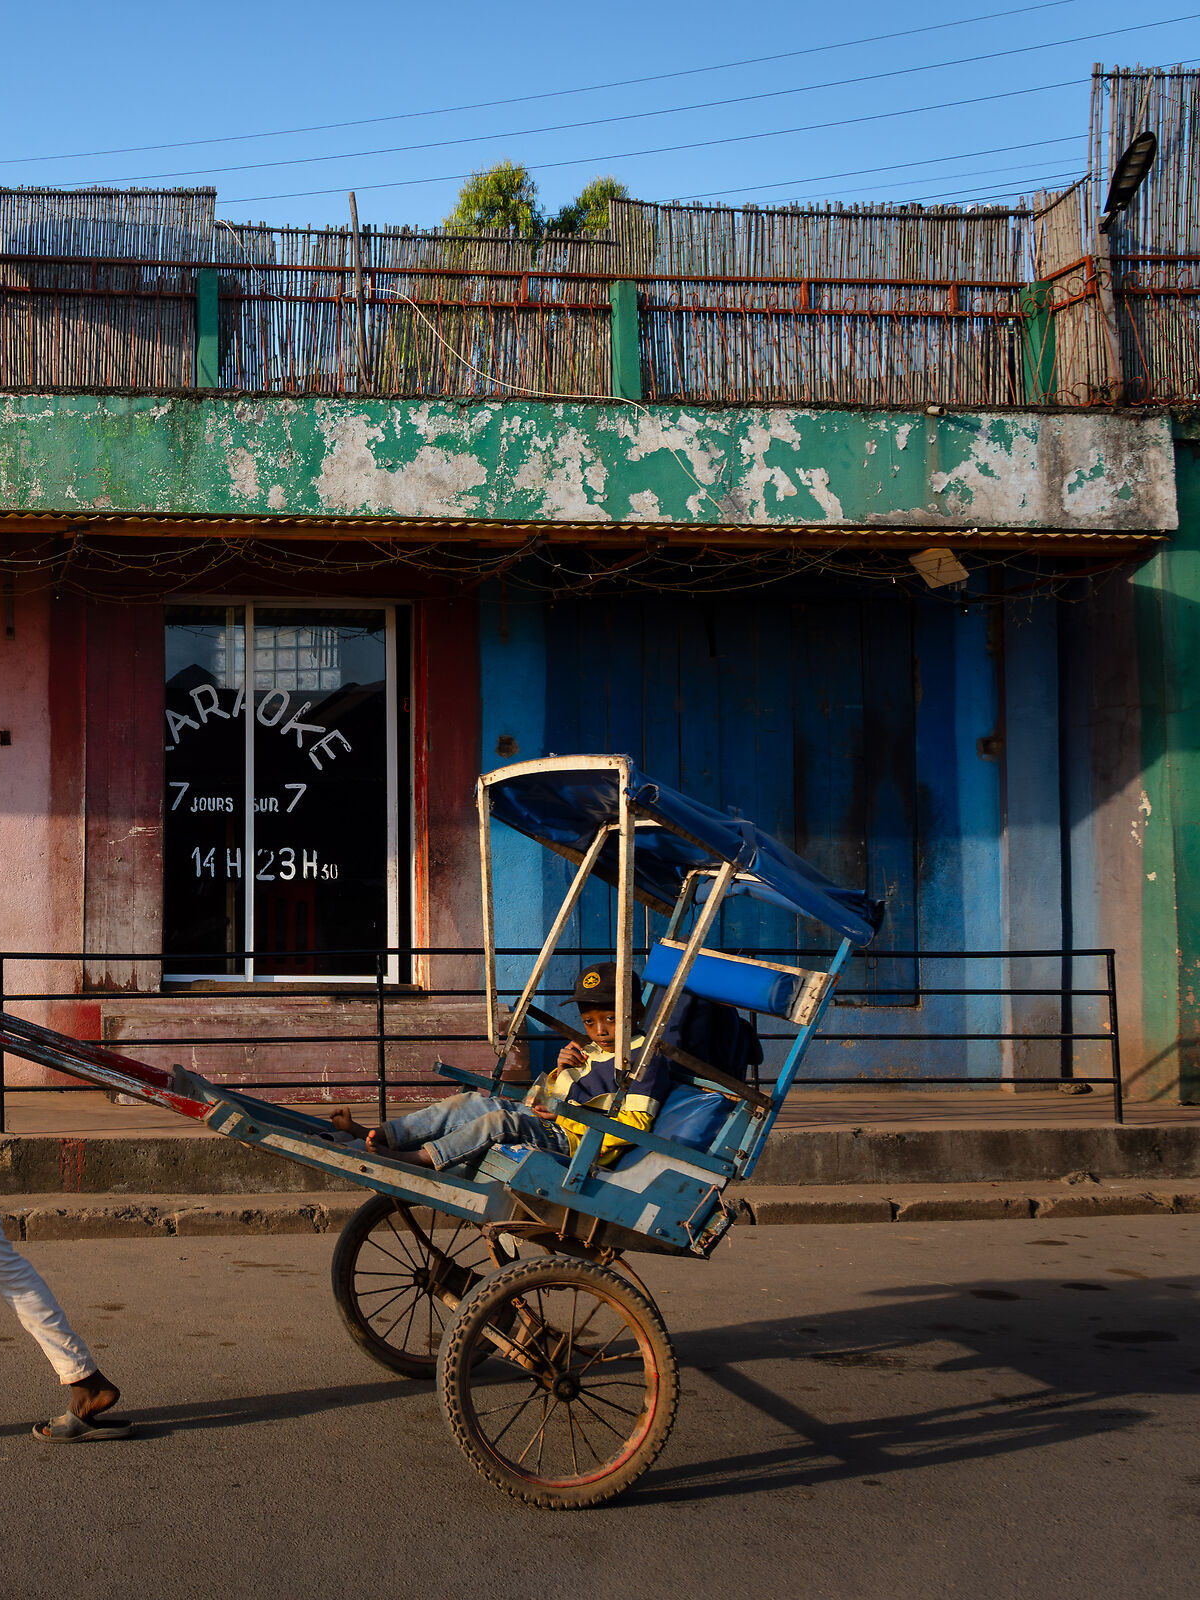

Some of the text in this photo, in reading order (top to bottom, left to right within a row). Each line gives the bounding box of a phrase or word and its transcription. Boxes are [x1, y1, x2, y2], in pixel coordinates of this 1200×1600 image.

[164, 684, 352, 771] AROKE
[169, 782, 190, 811] 7
[190, 797, 234, 813] JOURS
[285, 783, 307, 813] 7
